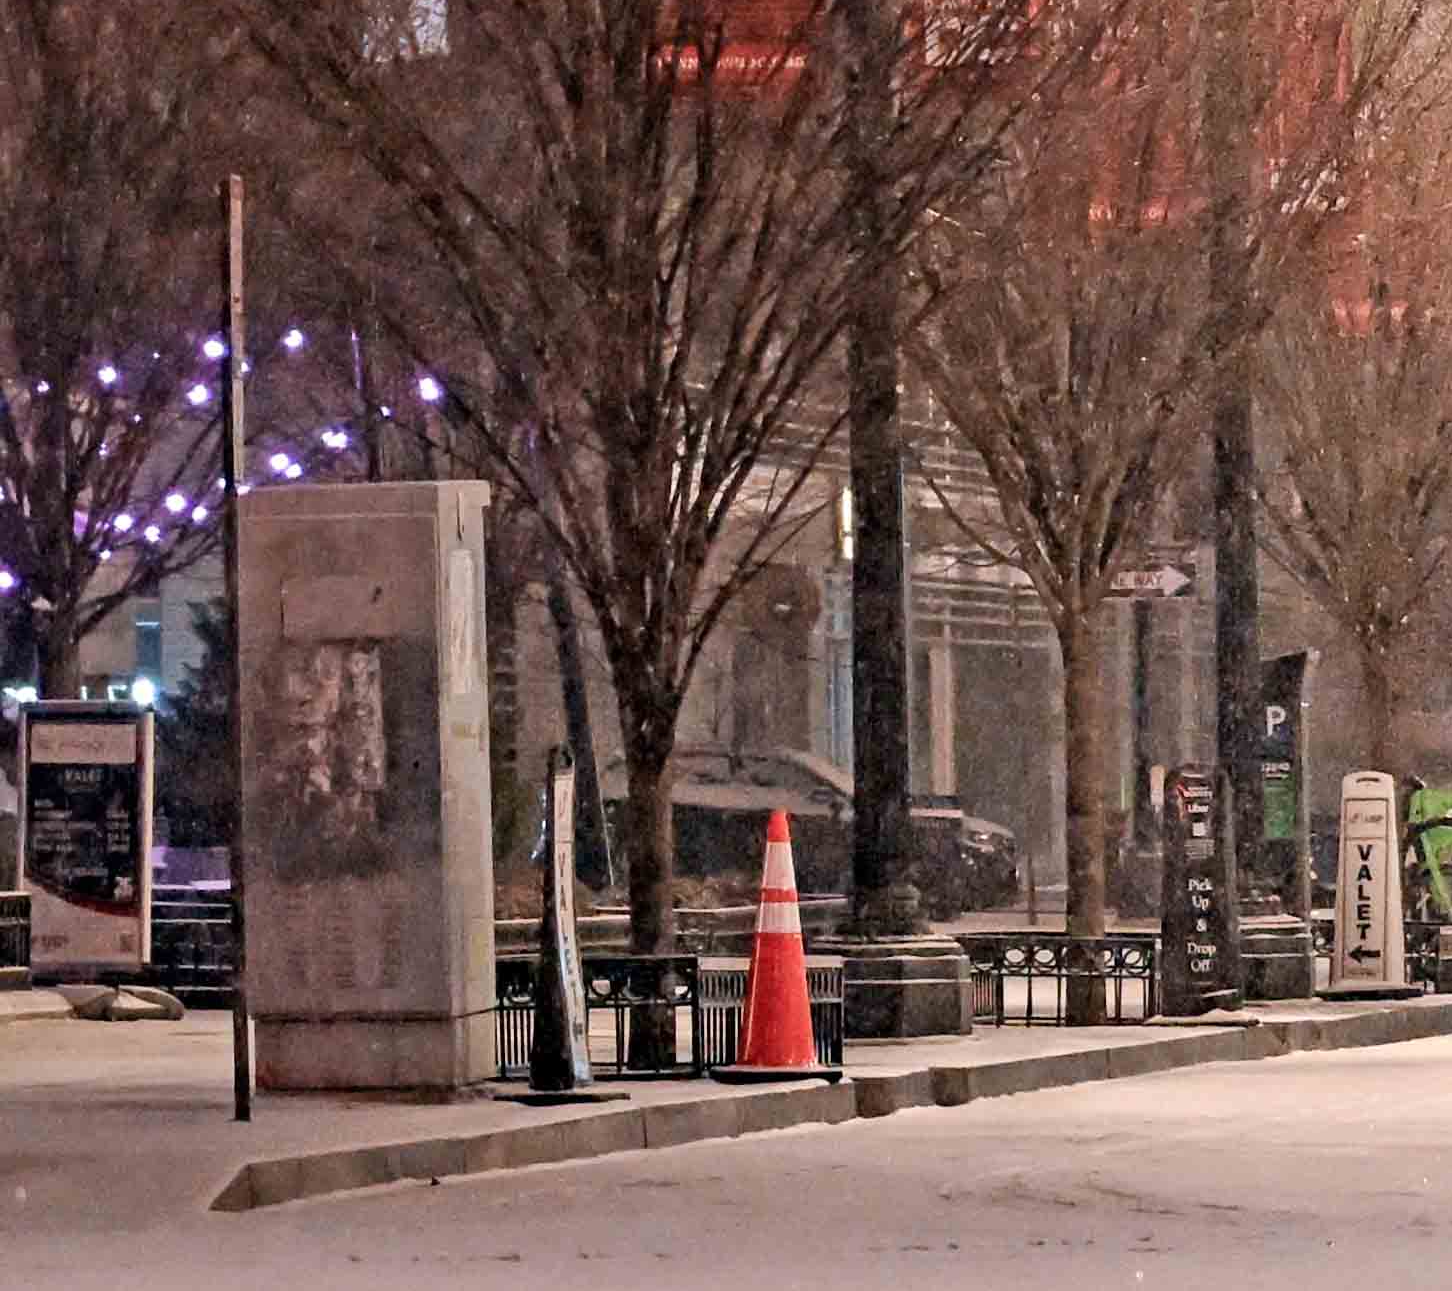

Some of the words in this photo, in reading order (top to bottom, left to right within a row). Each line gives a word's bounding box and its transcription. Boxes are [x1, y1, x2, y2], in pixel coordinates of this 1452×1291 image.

[1135, 572, 1163, 588] WAY
[1266, 705, 1287, 738] P
[1188, 878, 1214, 892] Pick
[1356, 844, 1373, 941] VALET
[1192, 895, 1210, 911] Up
[1196, 918, 1208, 933] &
[1187, 941, 1217, 956] Drop
[1190, 959, 1212, 973] Off
